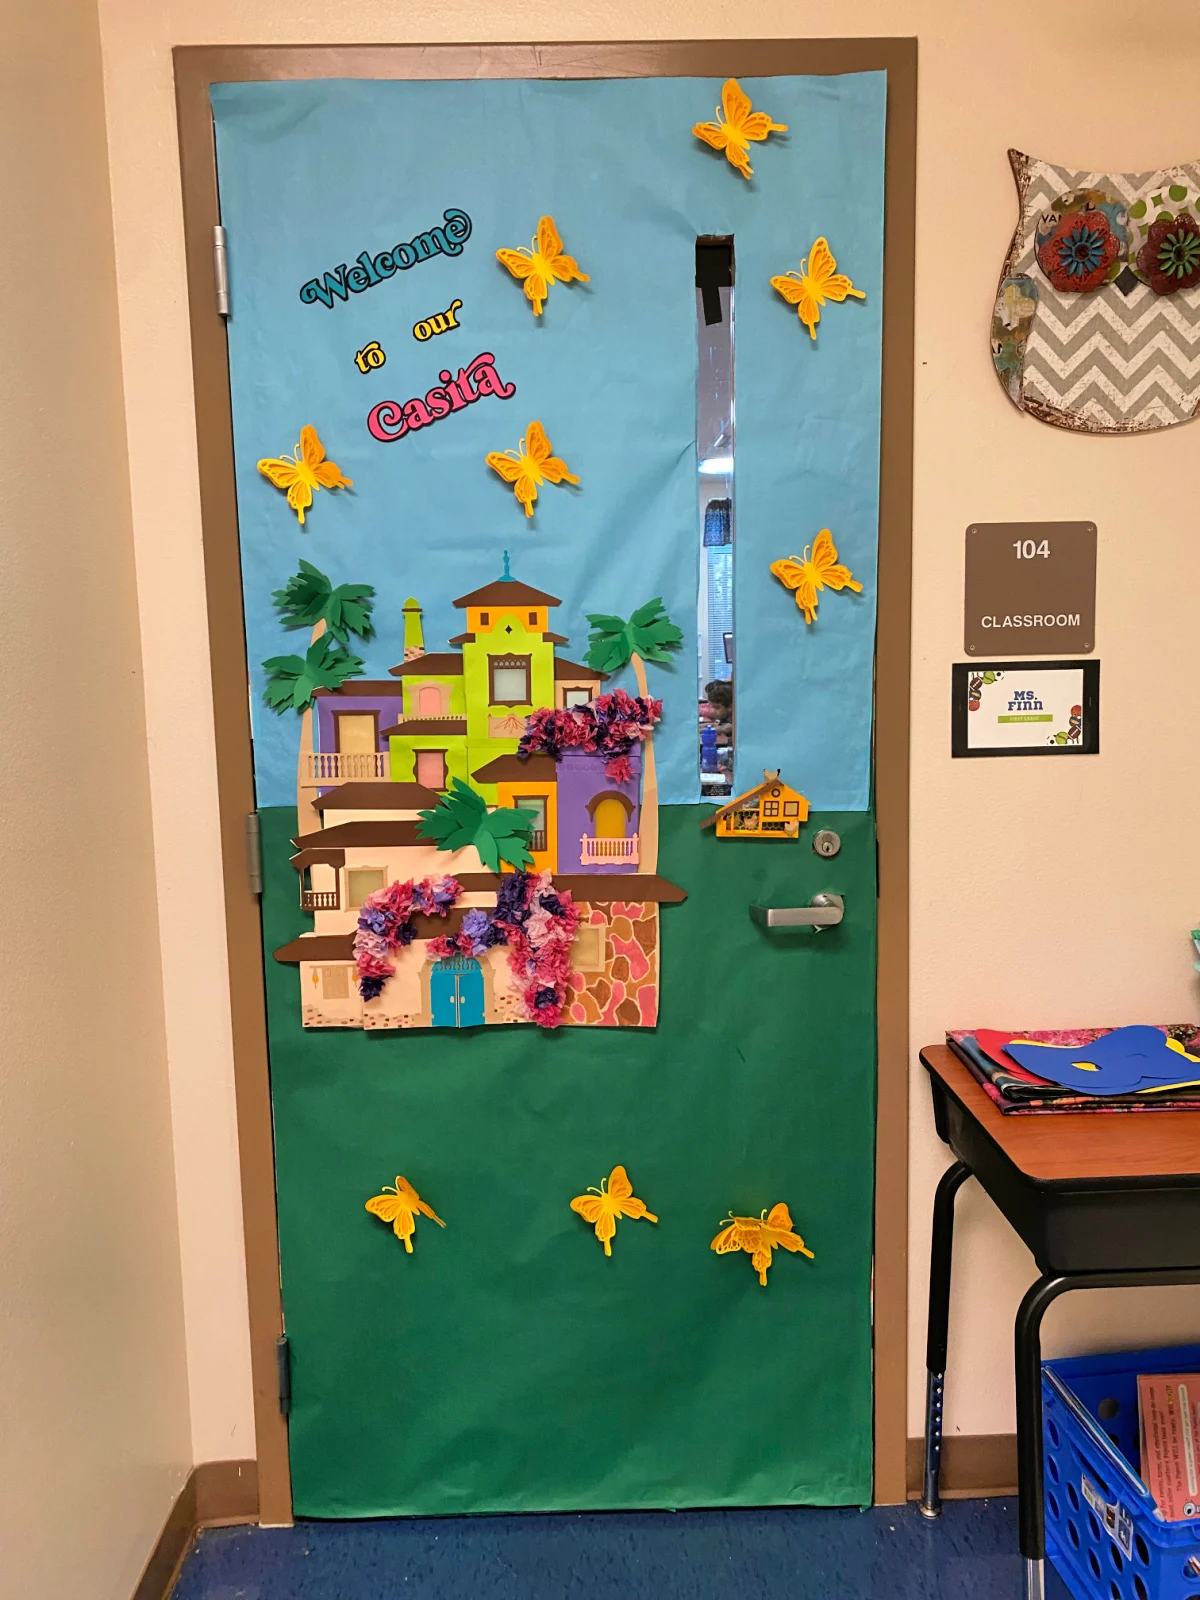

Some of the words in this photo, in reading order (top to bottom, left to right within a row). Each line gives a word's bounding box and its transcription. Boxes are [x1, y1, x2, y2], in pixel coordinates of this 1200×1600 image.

[300, 208, 472, 309] Welcome
[355, 341, 386, 374] to
[413, 299, 463, 341] our
[367, 352, 516, 442] Casita
[1012, 539, 1051, 559] 104
[981, 614, 1081, 628] CLASSROOM
